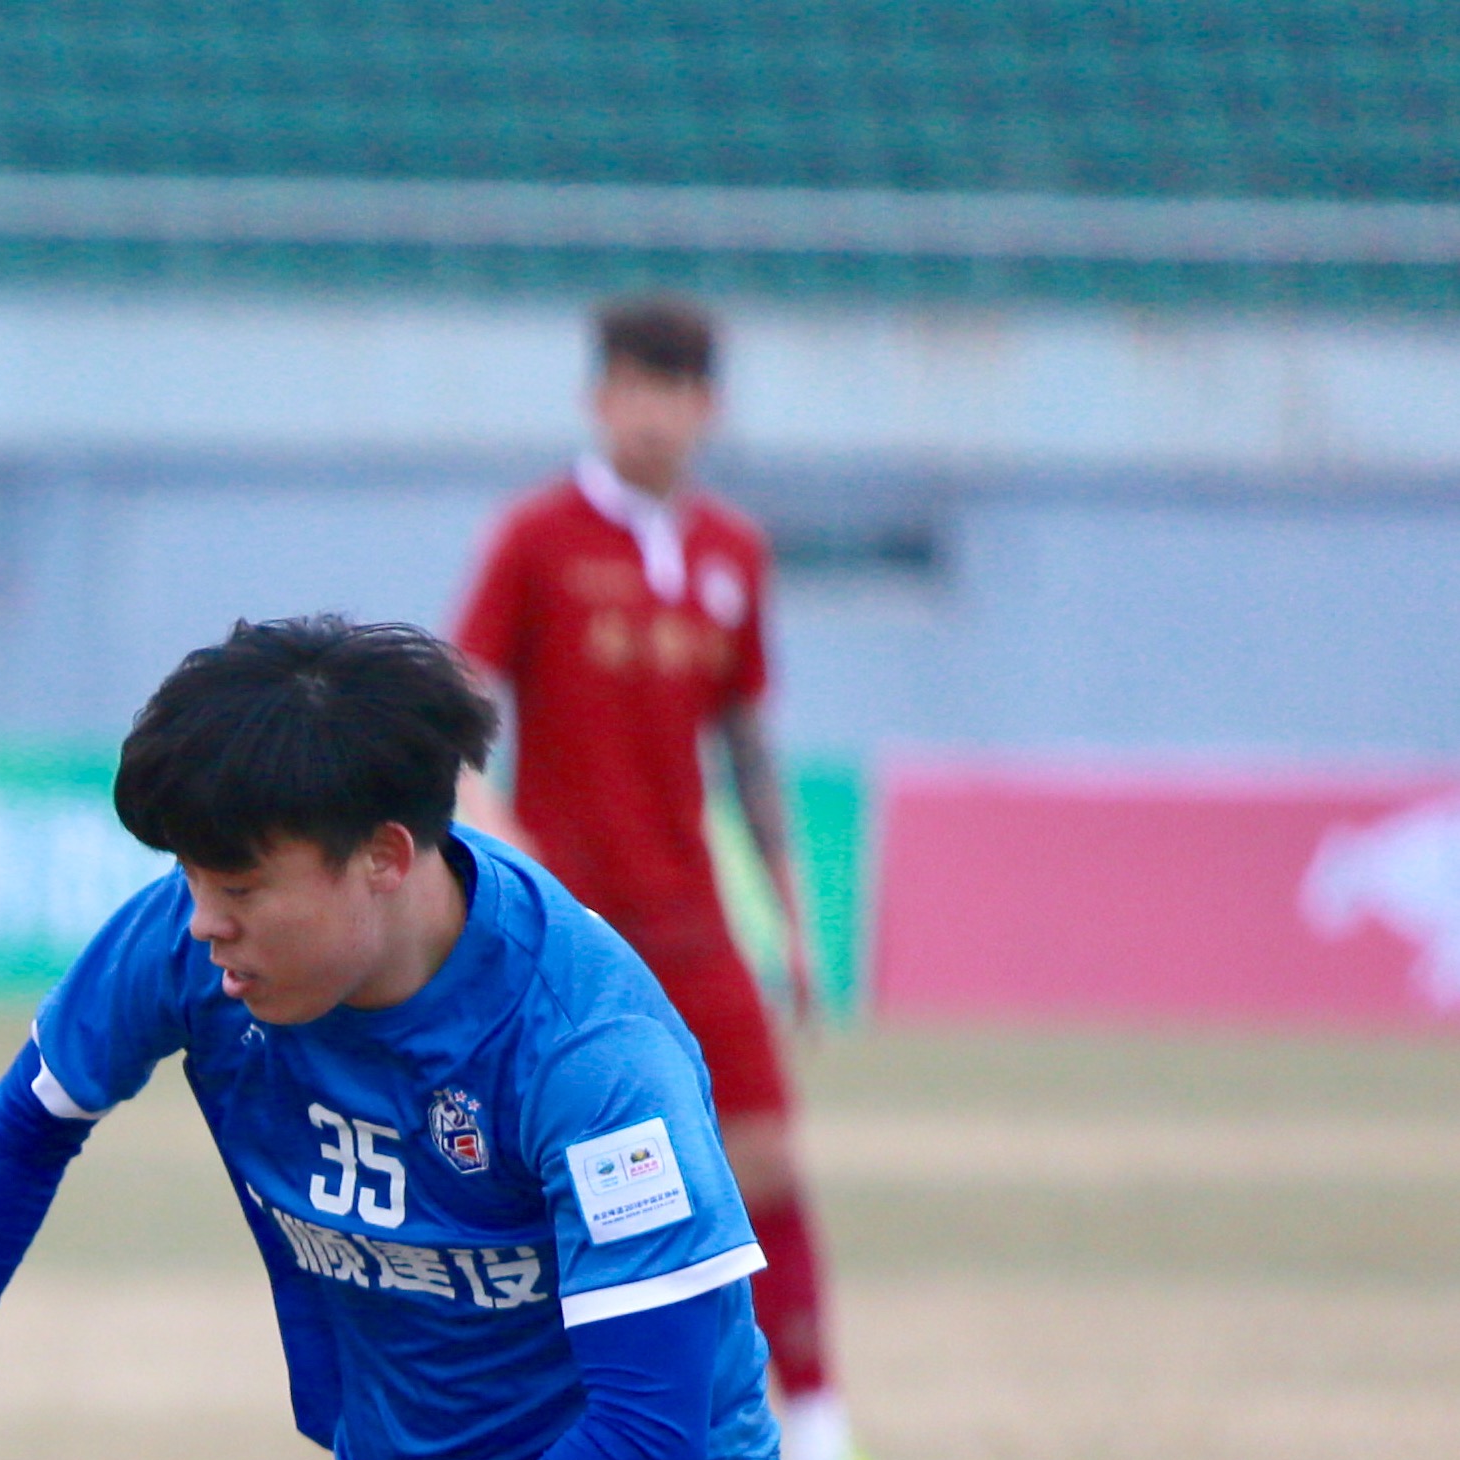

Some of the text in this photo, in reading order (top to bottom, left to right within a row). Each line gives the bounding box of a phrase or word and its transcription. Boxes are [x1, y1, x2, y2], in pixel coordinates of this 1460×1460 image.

[307, 1101, 406, 1230] 35
[245, 1181, 548, 1310] 顺建设
